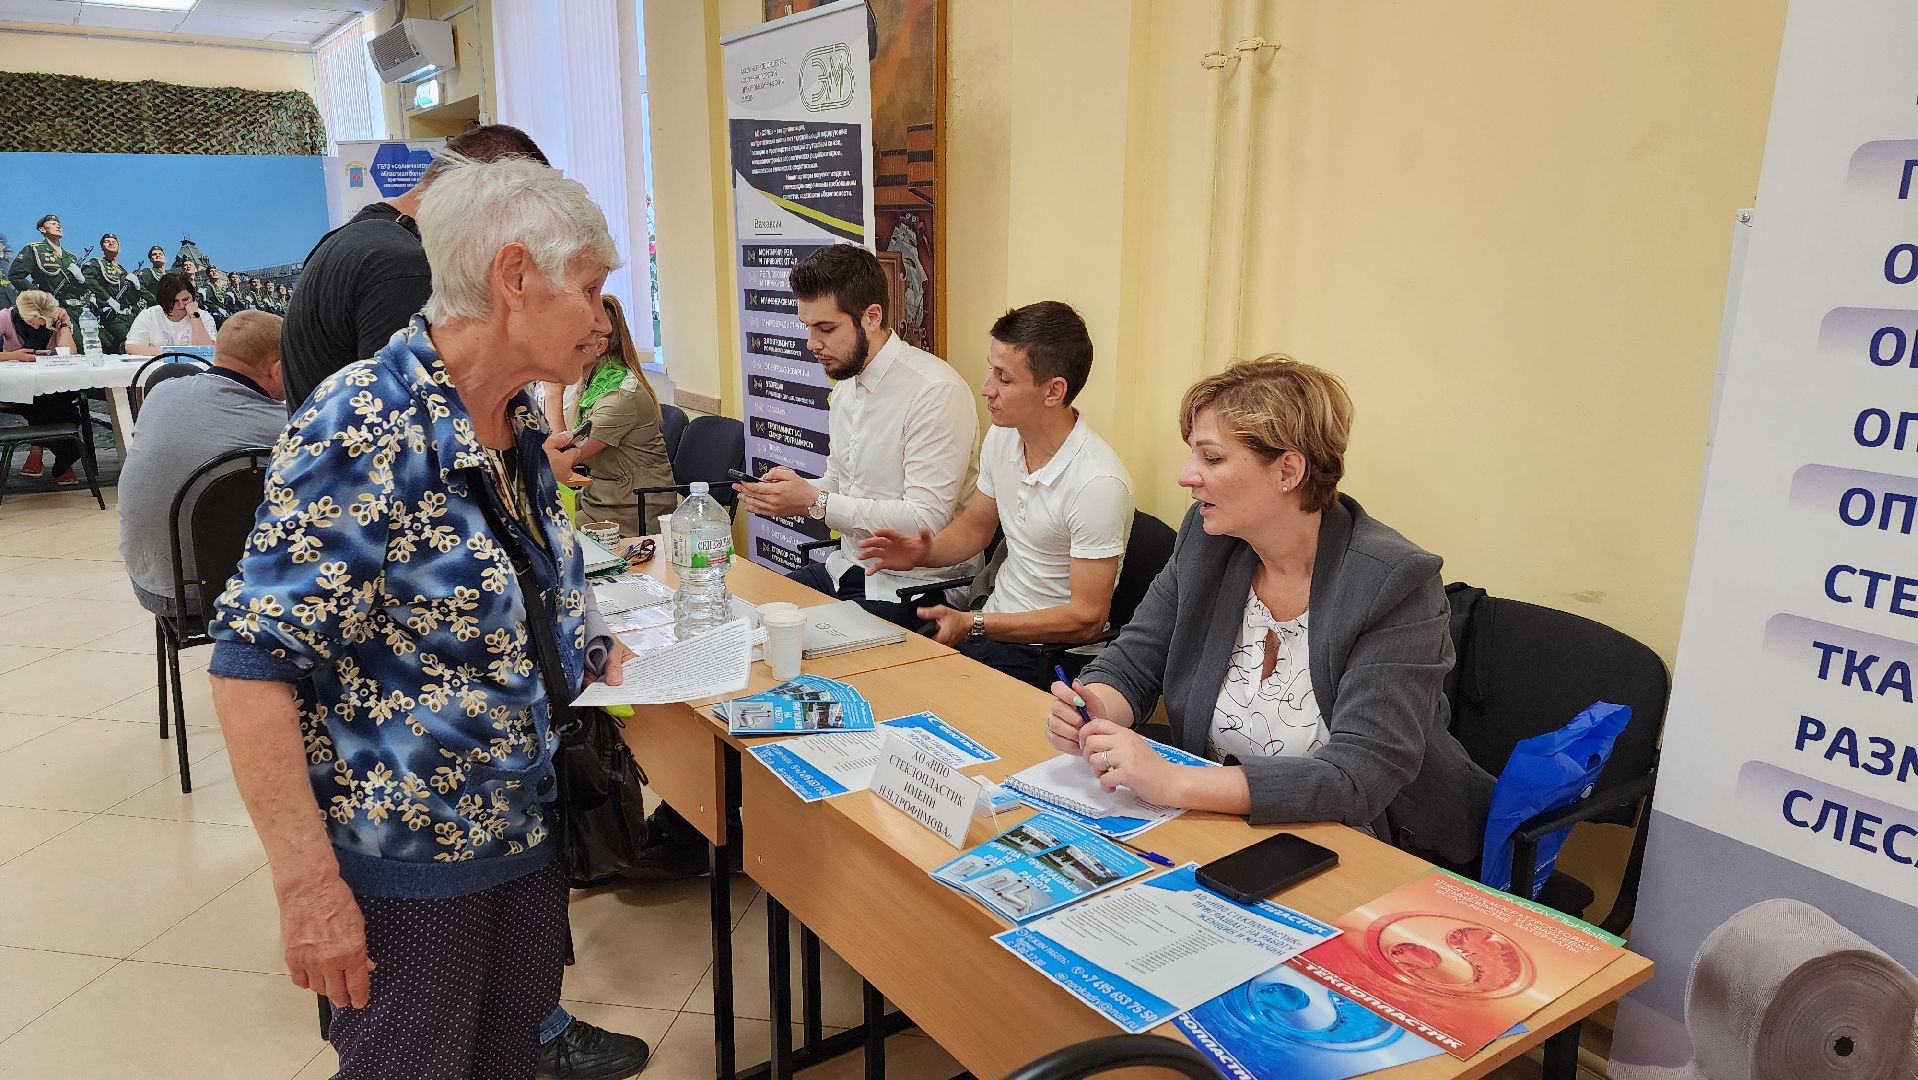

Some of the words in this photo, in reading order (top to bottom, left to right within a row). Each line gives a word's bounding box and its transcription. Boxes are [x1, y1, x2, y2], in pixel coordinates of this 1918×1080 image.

[1869, 326, 1918, 368] О
[1824, 564, 1918, 618] СТЕ
[1812, 641, 1914, 704] ТКА
[889, 754, 966, 808] СТЕКЛОПЛАСТИК
[912, 750, 926, 764] АО
[926, 759, 950, 778] «НПО
[903, 781, 937, 809] ИМЕНИ
[1782, 790, 1918, 868] СЛЕС
[1018, 870, 1054, 893] РАБОТУ
[1193, 893, 1208, 901] АО
[1192, 901, 1250, 931] ПРИГЛАШАЕТ
[1249, 928, 1262, 938] НА
[1260, 933, 1297, 951] РАБОТУ
[1199, 914, 1236, 935] ЖЕНЩИН
[1235, 930, 1244, 939] И
[1242, 935, 1287, 956] МУЖЧИН
[1093, 980, 1115, 994] 495
[1109, 991, 1133, 1005] 653
[1127, 1001, 1146, 1013] 75
[1140, 1009, 1159, 1022] 50
[1305, 962, 1463, 1049] ТЕКЛОПЛАСТИК
